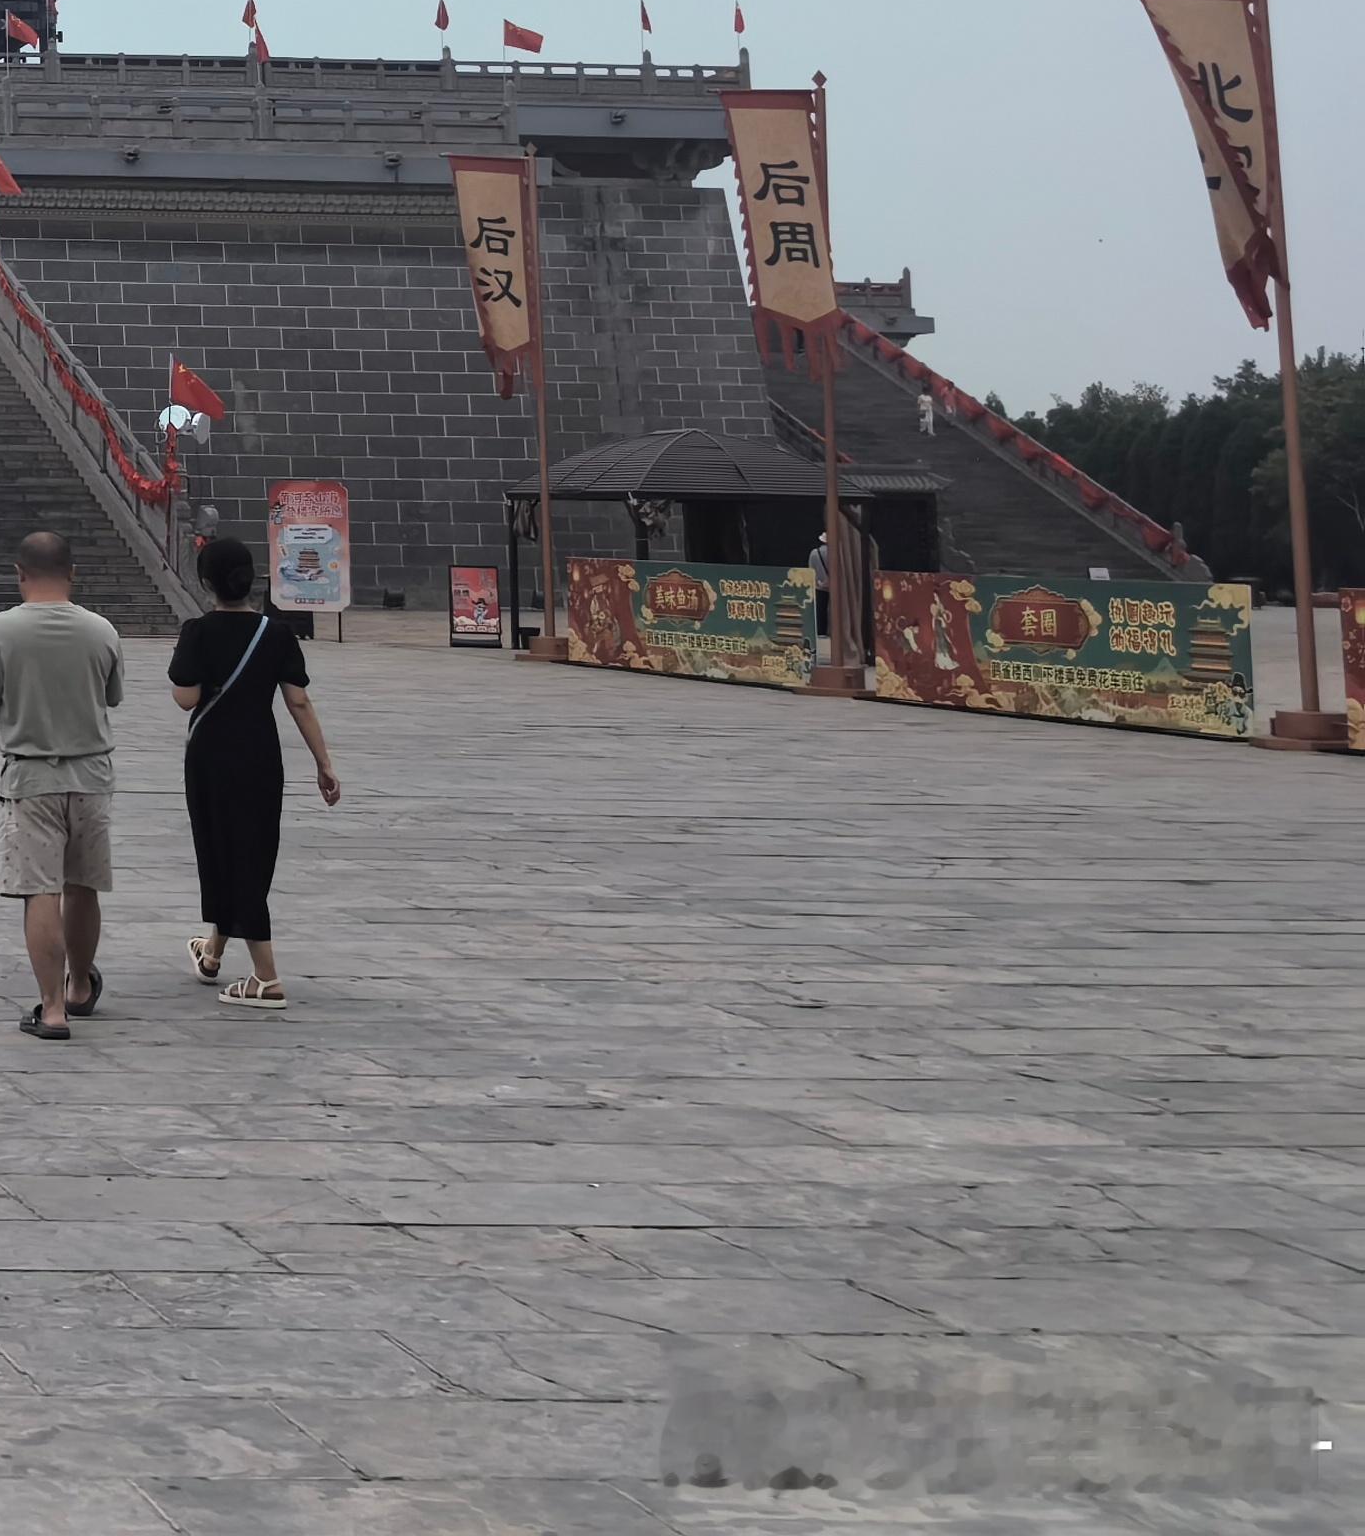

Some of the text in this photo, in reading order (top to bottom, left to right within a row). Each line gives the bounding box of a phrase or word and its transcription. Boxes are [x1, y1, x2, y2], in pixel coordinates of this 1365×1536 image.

[753, 160, 821, 269] 后周
[469, 217, 523, 308] 后汉
[655, 585, 700, 611] 美味鱼汤
[1020, 607, 1057, 637] 套圈
